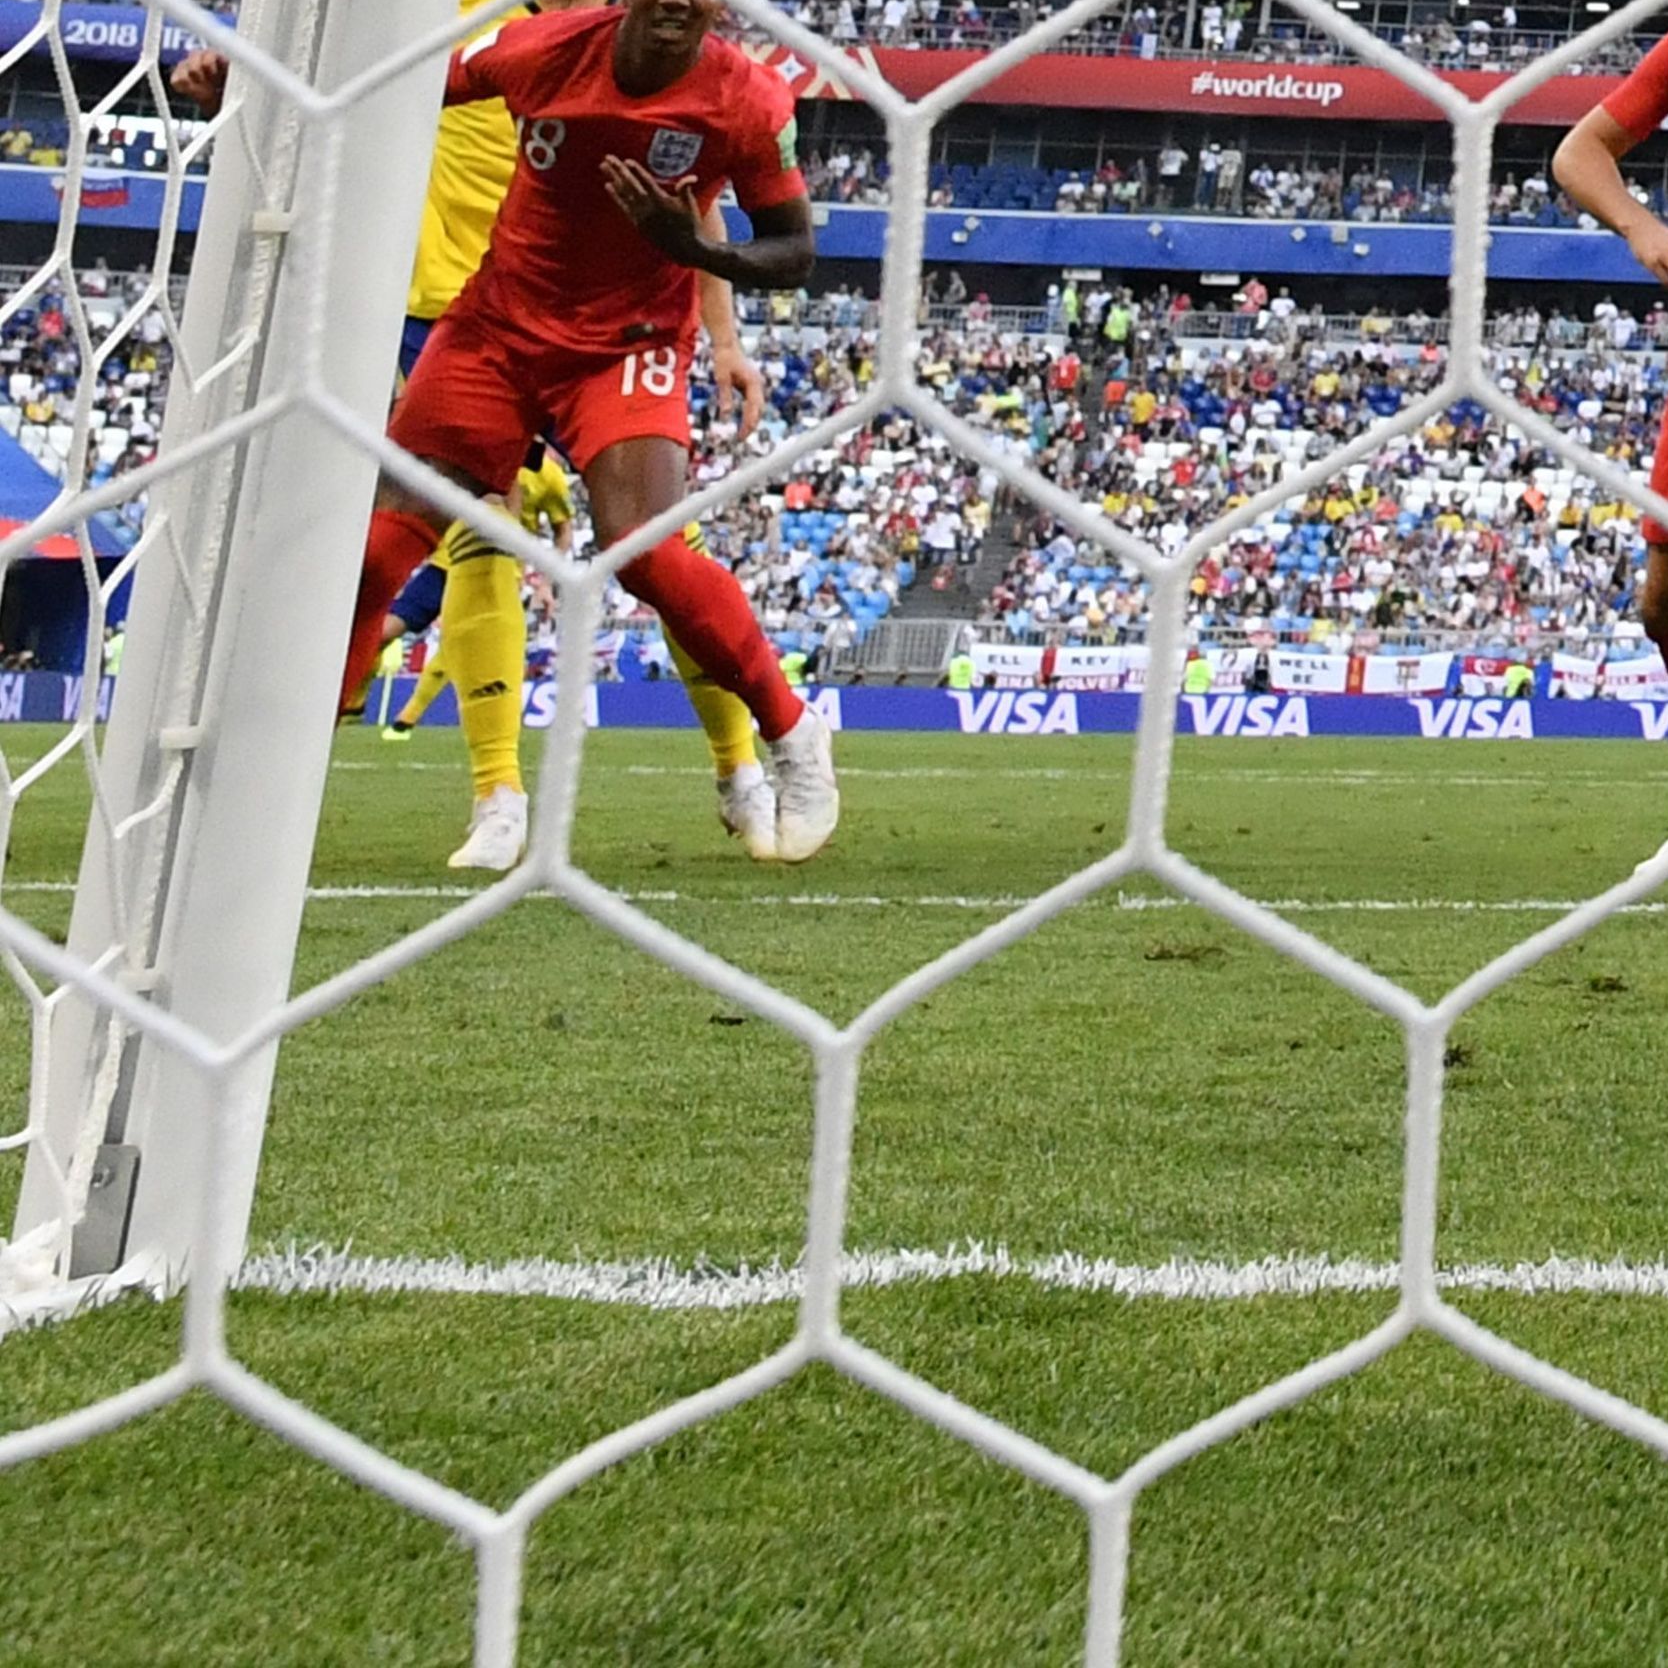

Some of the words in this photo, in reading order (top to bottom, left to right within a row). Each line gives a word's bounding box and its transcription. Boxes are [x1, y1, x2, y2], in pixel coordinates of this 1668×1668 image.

[63, 19, 139, 48] 2018
[1190, 70, 1344, 107] #worldcup
[620, 346, 677, 397] 18
[946, 690, 1080, 734] VISA
[1181, 694, 1310, 737] VISA
[1407, 697, 1534, 740] VISA
